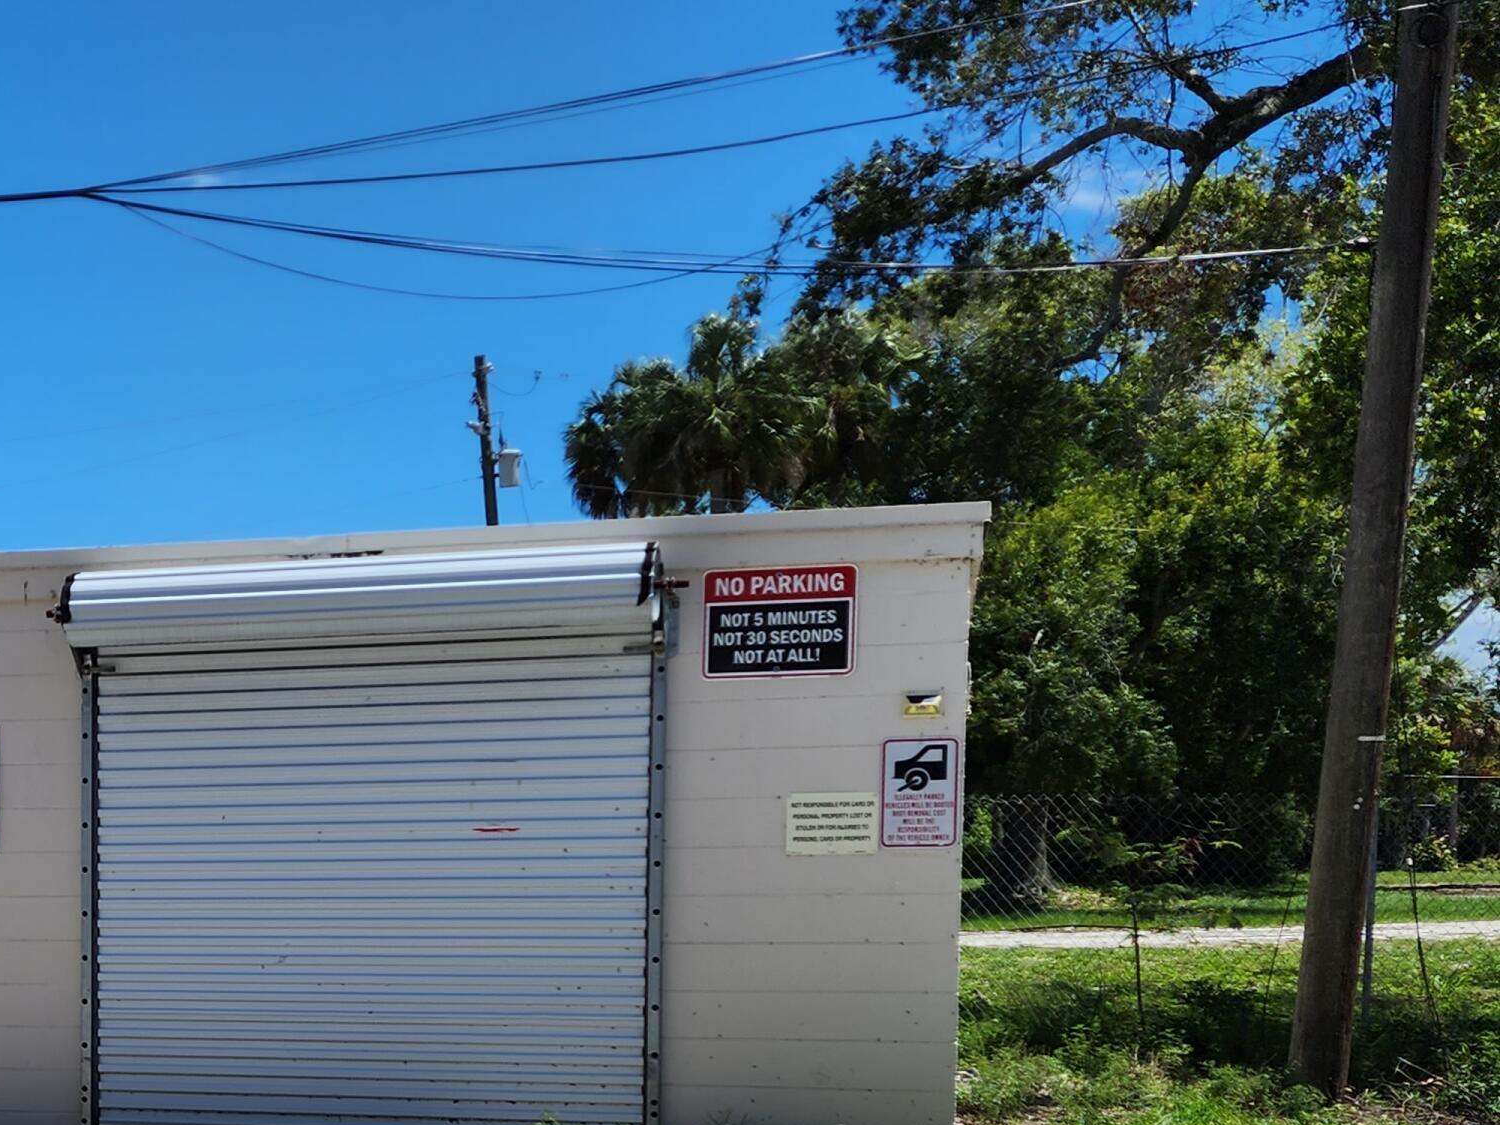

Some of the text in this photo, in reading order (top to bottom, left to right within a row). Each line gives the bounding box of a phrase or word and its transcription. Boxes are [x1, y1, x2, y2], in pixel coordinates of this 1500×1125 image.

[715, 572, 845, 596] NO PARKING
[720, 610, 837, 627] NOT 5 MINUTES
[714, 628, 844, 646] NOT 30 SECONDS
[732, 648, 820, 664] NOT AT ALL!
